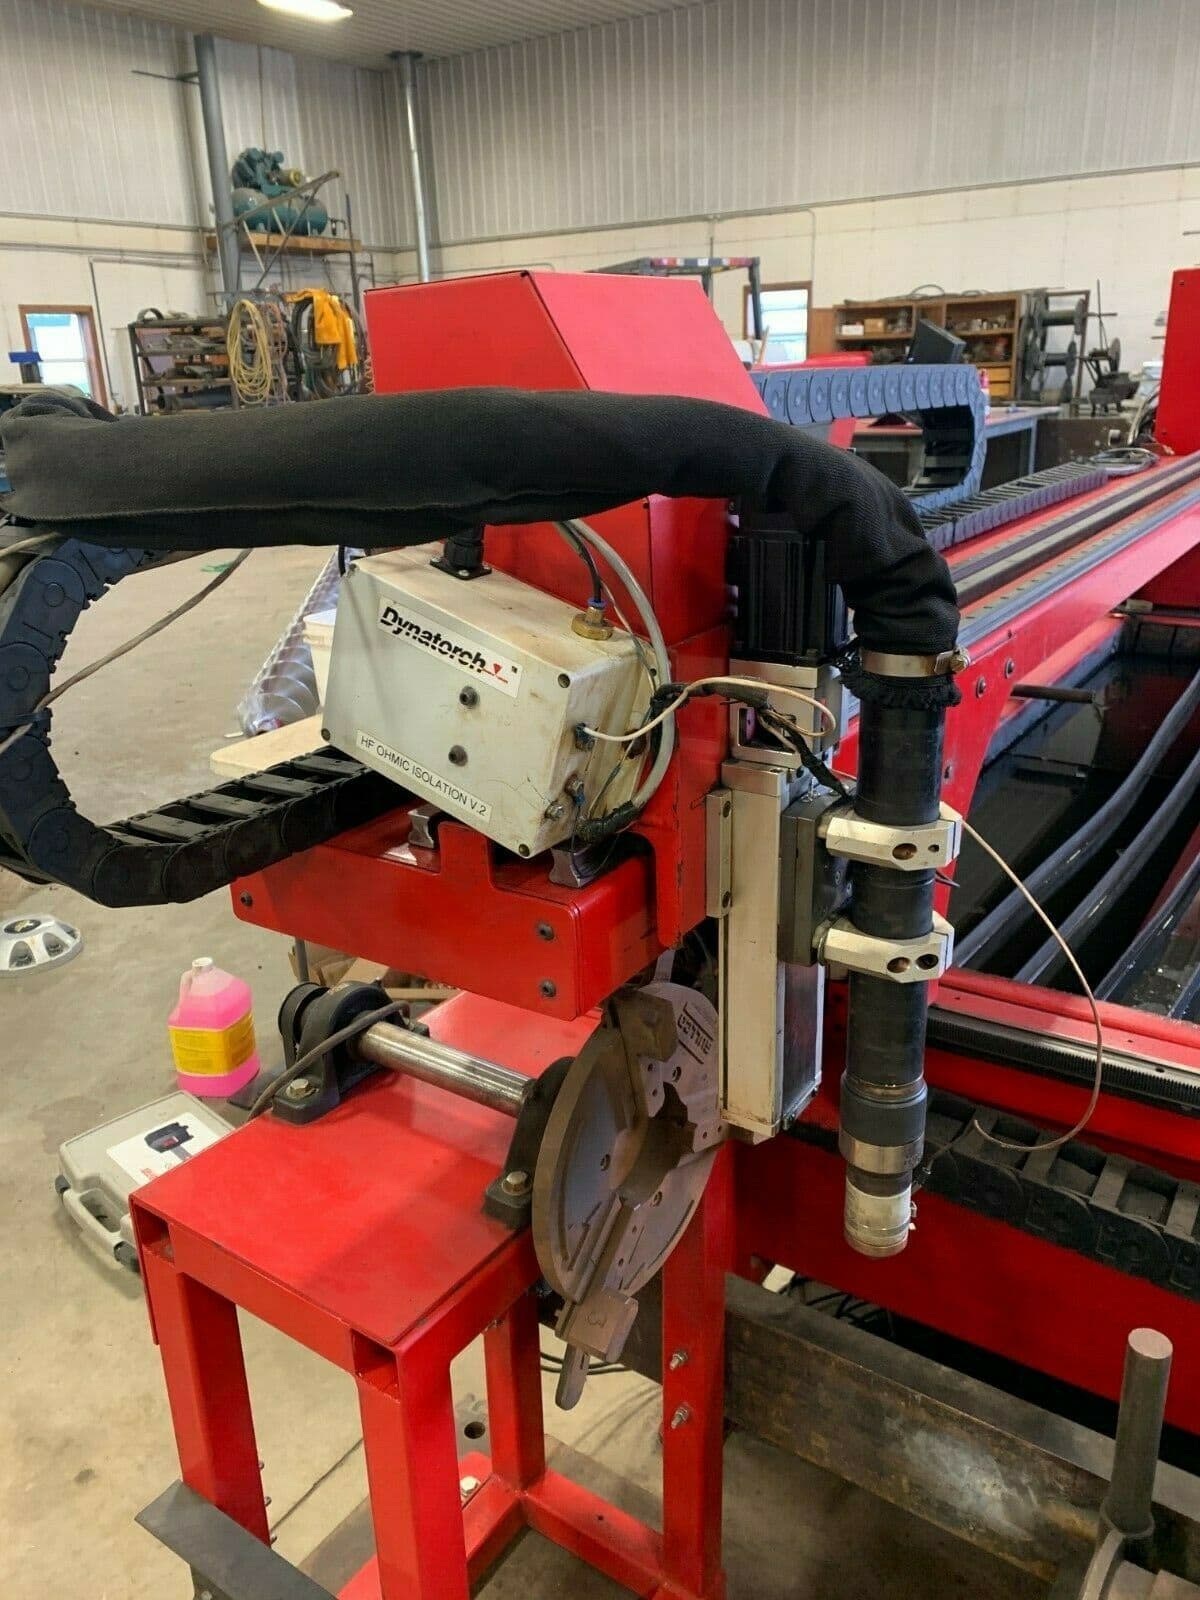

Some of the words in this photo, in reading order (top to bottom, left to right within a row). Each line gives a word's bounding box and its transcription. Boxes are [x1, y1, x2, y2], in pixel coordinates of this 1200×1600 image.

[380, 606, 486, 673] Dynatorch
[360, 735, 375, 749] HF
[376, 745, 410, 771] OHMIC
[412, 765, 467, 805] ISOLATION
[470, 798, 487, 817] V.2
